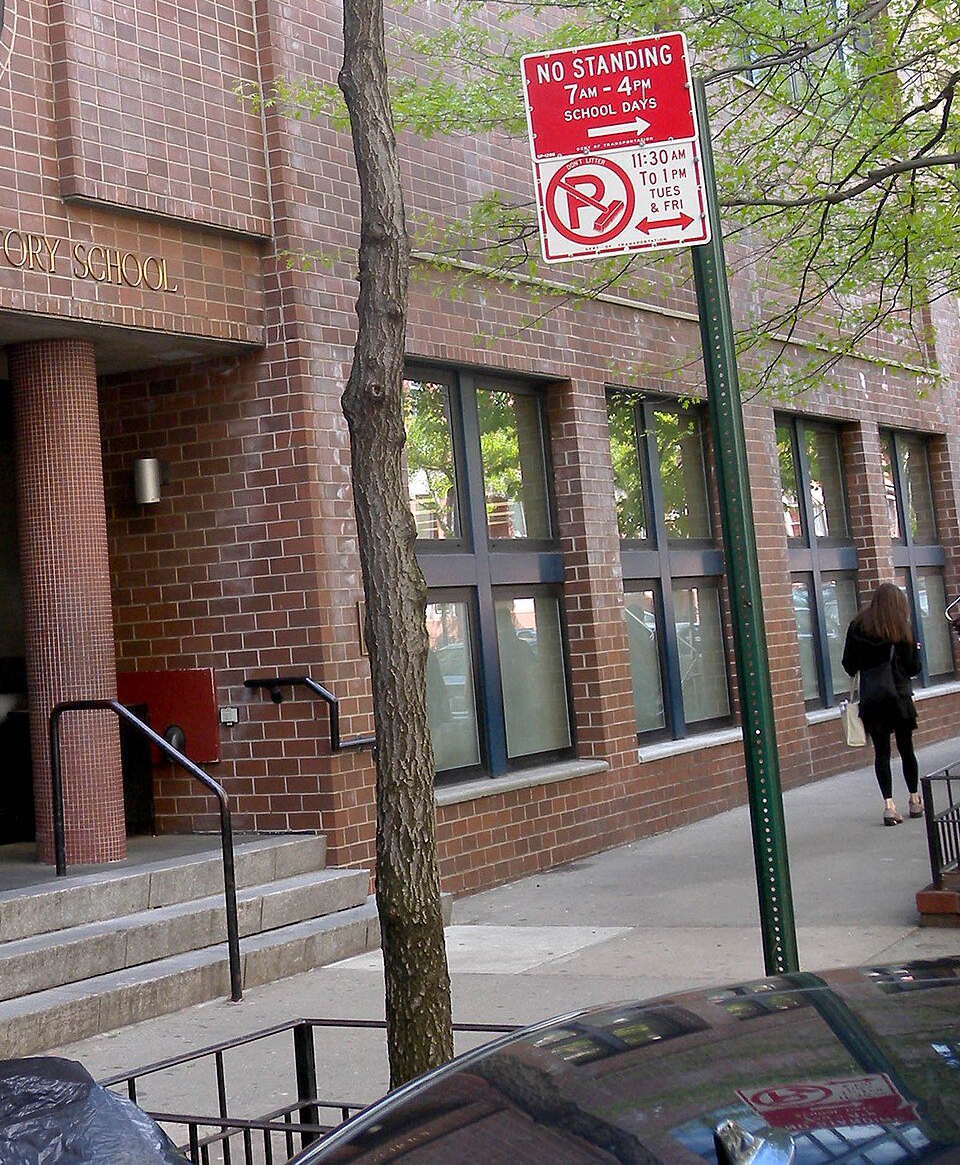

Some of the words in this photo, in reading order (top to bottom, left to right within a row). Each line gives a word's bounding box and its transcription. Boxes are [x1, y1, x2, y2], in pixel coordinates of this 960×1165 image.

[536, 61, 564, 84] NO
[572, 44, 673, 79] STANDING
[563, 104, 617, 122] SCHOOL
[622, 98, 657, 113] DAYS
[585, 157, 606, 166] LITTER
[649, 185, 681, 199] TUES
[650, 203, 659, 213] &
[664, 199, 684, 211] FRI
[72, 243, 178, 293] SCHOOL
